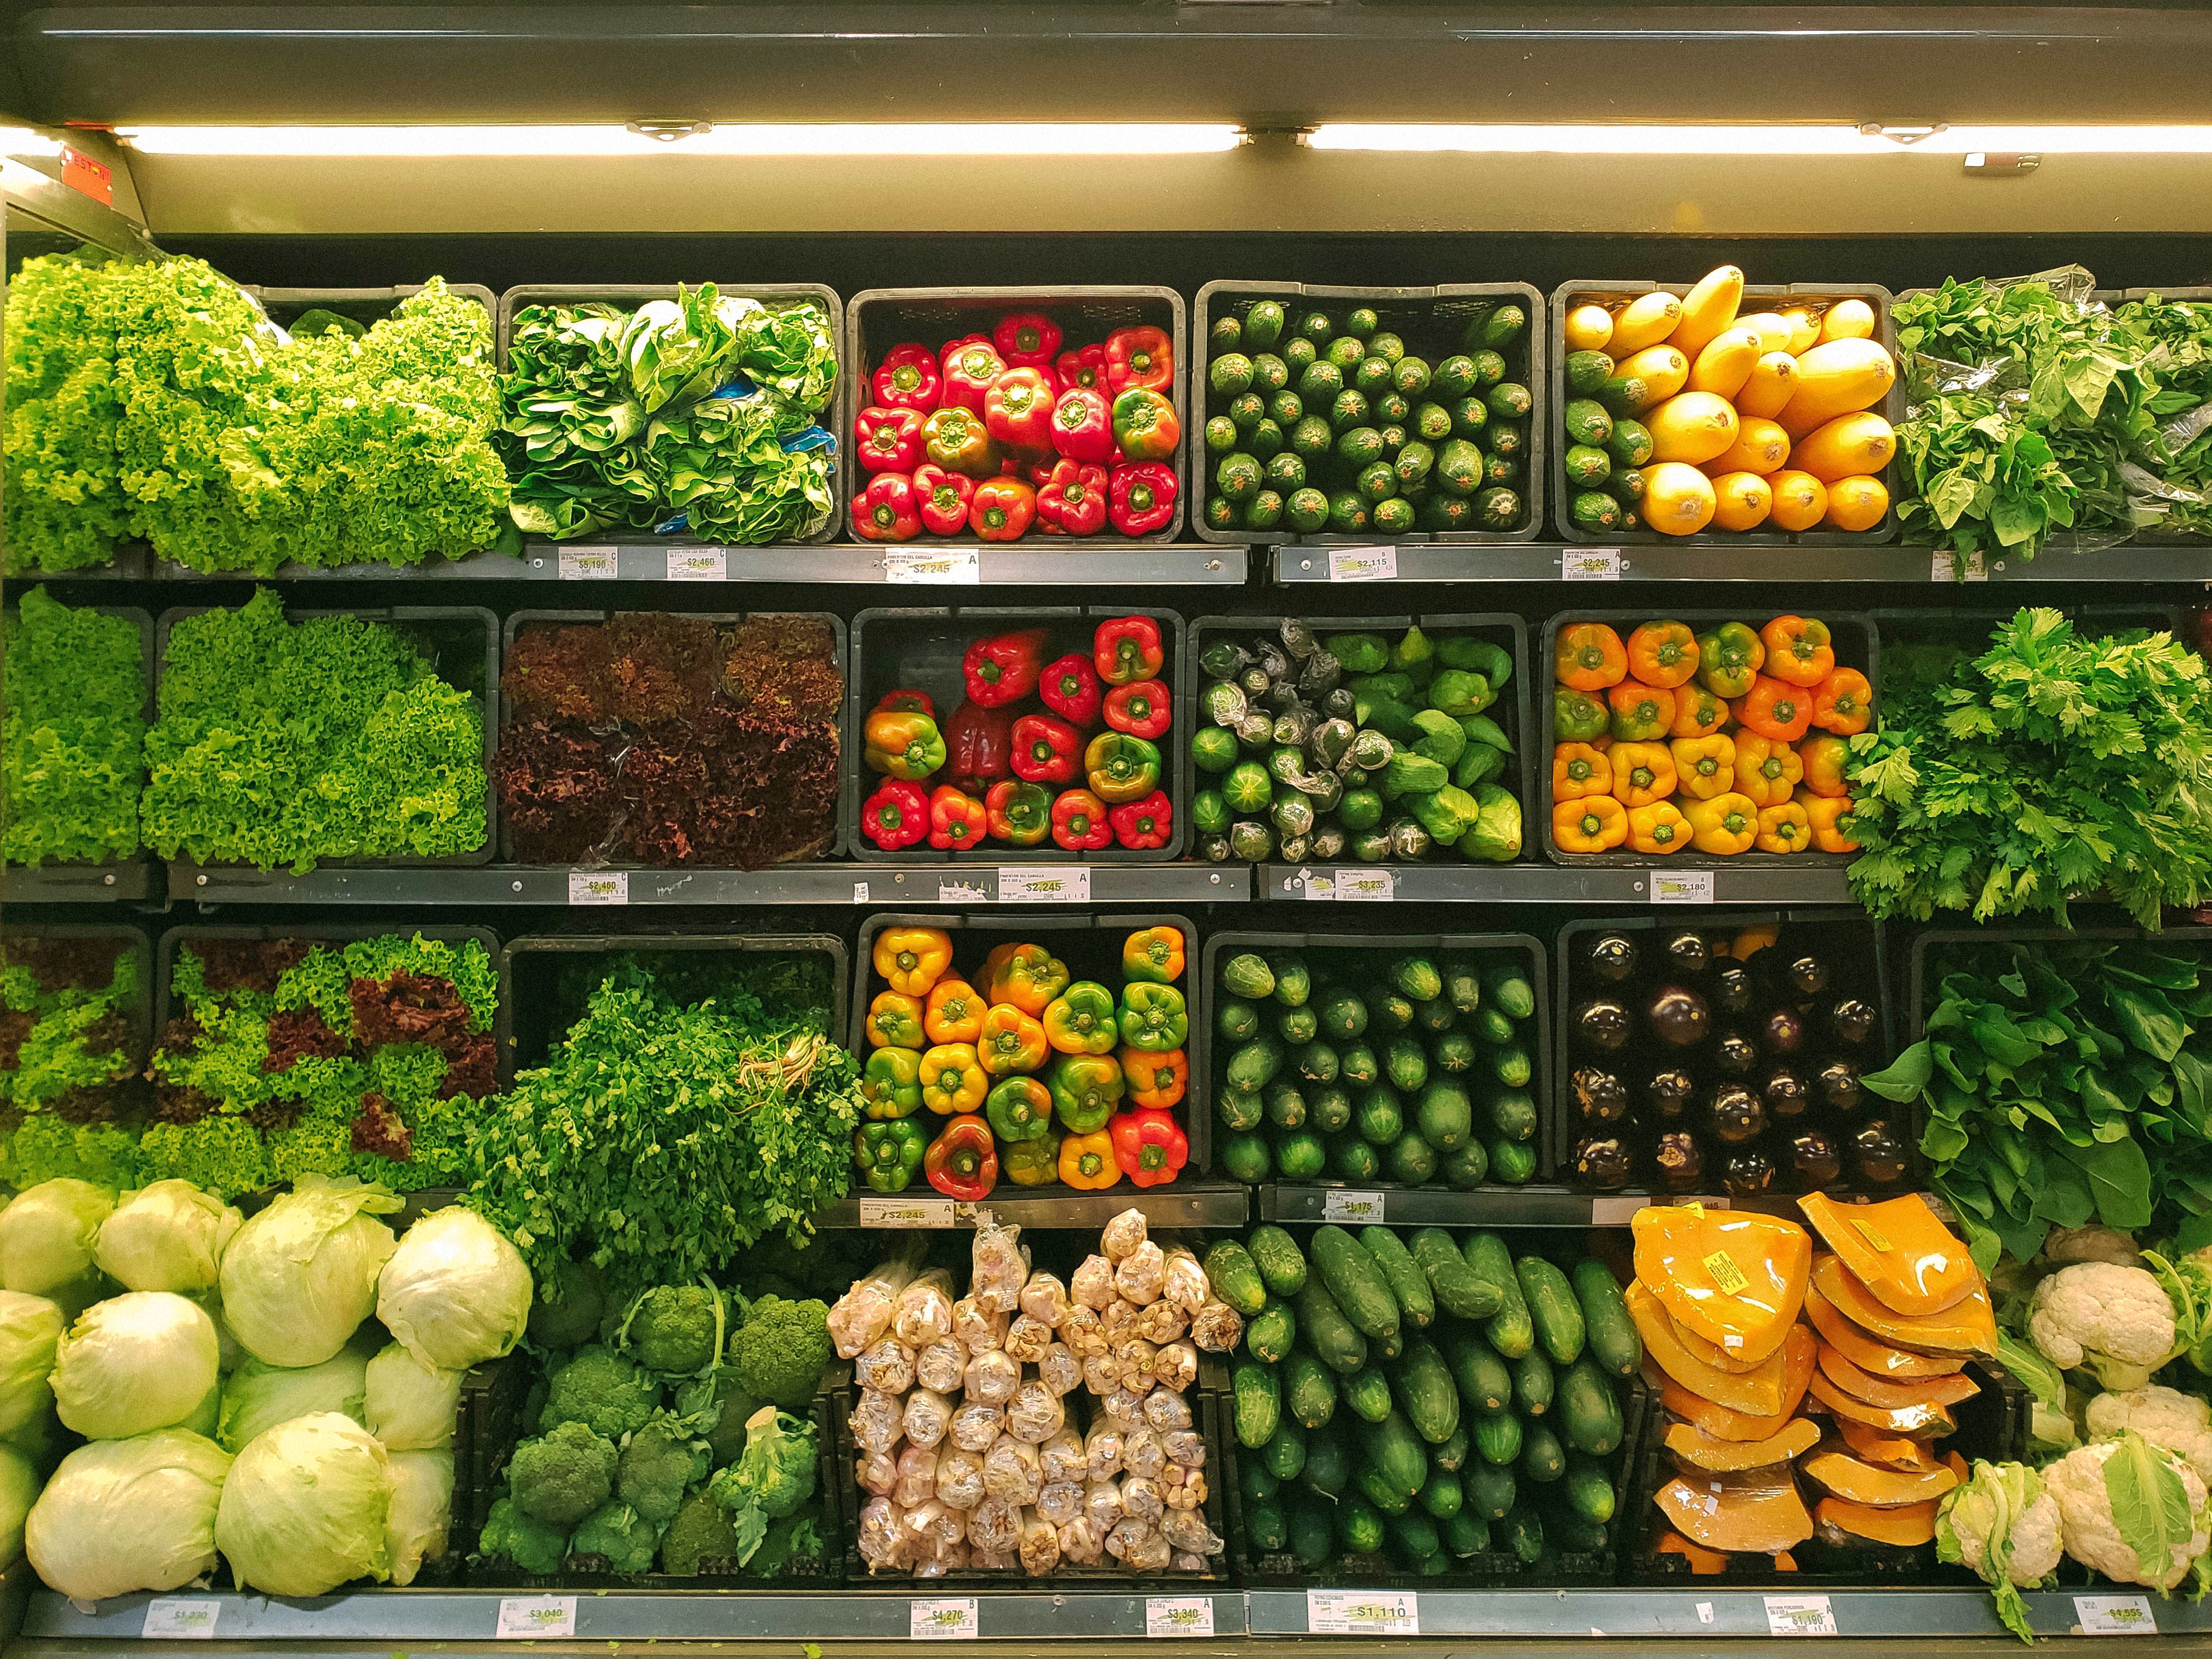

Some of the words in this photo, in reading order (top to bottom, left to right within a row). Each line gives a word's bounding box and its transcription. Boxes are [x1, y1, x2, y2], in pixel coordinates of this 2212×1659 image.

[687, 558, 714, 567] $2,460
[968, 555, 977, 565] A
[1357, 558, 1386, 567] $2,115
[1583, 558, 1610, 567] $2,245
[579, 560, 605, 570] $5,190
[913, 565, 950, 573] $2245
[622, 873, 626, 881] C
[1079, 873, 1087, 882] A
[589, 881, 616, 890] $2,460
[1026, 883, 1061, 893] $2,245
[1358, 880, 1385, 889] $3,235
[889, 1211, 925, 1220] $2,245
[969, 1599, 974, 1609] B
[1204, 1598, 1210, 1608] A
[1357, 1607, 1406, 1618] $1,110
[1826, 1605, 1833, 1614] A
[932, 1610, 963, 1622] $4,270
[1168, 1609, 1199, 1620] $3,340
[1792, 1614, 1823, 1625] $1,190
